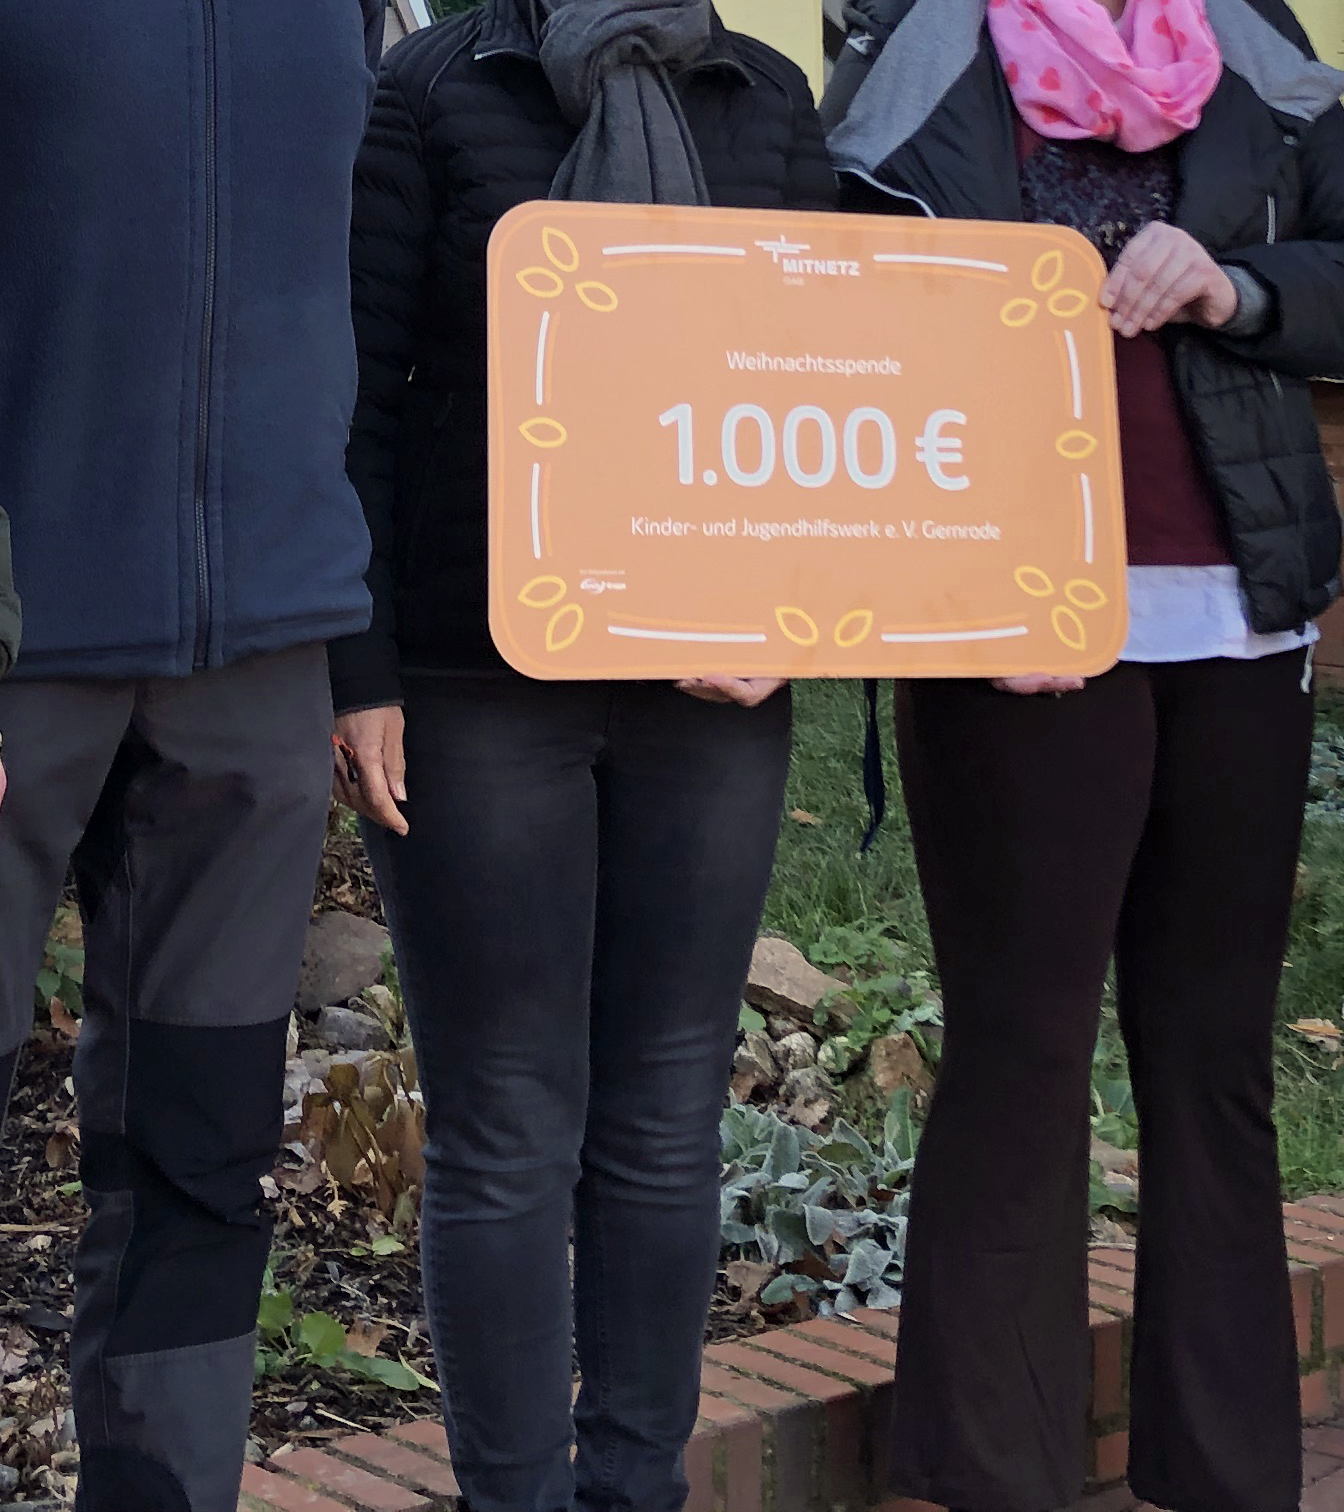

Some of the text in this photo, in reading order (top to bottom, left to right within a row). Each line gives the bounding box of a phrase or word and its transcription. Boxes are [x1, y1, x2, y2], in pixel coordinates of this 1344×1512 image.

[782, 258, 861, 276] MITNETZ
[726, 351, 902, 377] Weihnachtsspende
[658, 403, 971, 491] 1.000 €
[631, 517, 697, 536] Kinder-
[702, 518, 736, 537] und
[742, 518, 881, 541] Jugendhilfswerk
[885, 523, 899, 538] e.
[902, 520, 918, 539] V.
